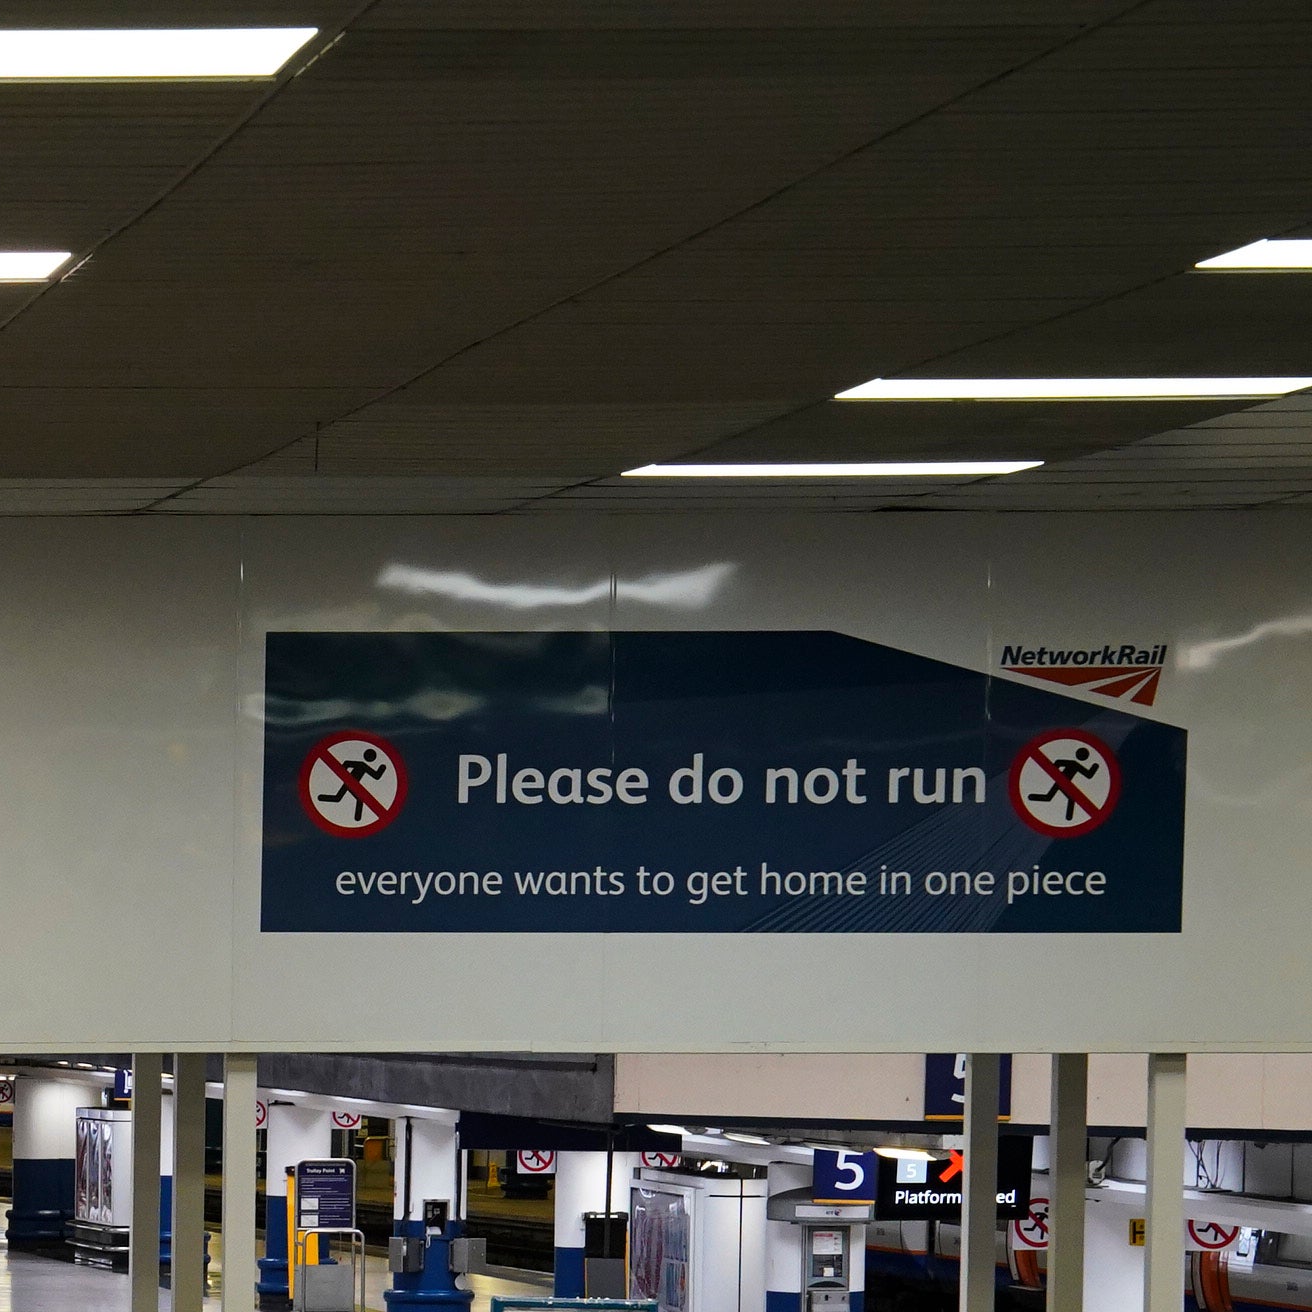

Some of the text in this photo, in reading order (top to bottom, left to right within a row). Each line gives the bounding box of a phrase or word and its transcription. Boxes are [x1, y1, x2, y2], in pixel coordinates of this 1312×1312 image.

[1000, 645, 1168, 670] NetworkRail
[458, 753, 986, 805] Please do not run
[335, 863, 1107, 905] everyone wants to get home in one piece
[834, 1150, 865, 1191] 5
[906, 1163, 917, 1179] 5
[895, 1190, 963, 1205] Platform
